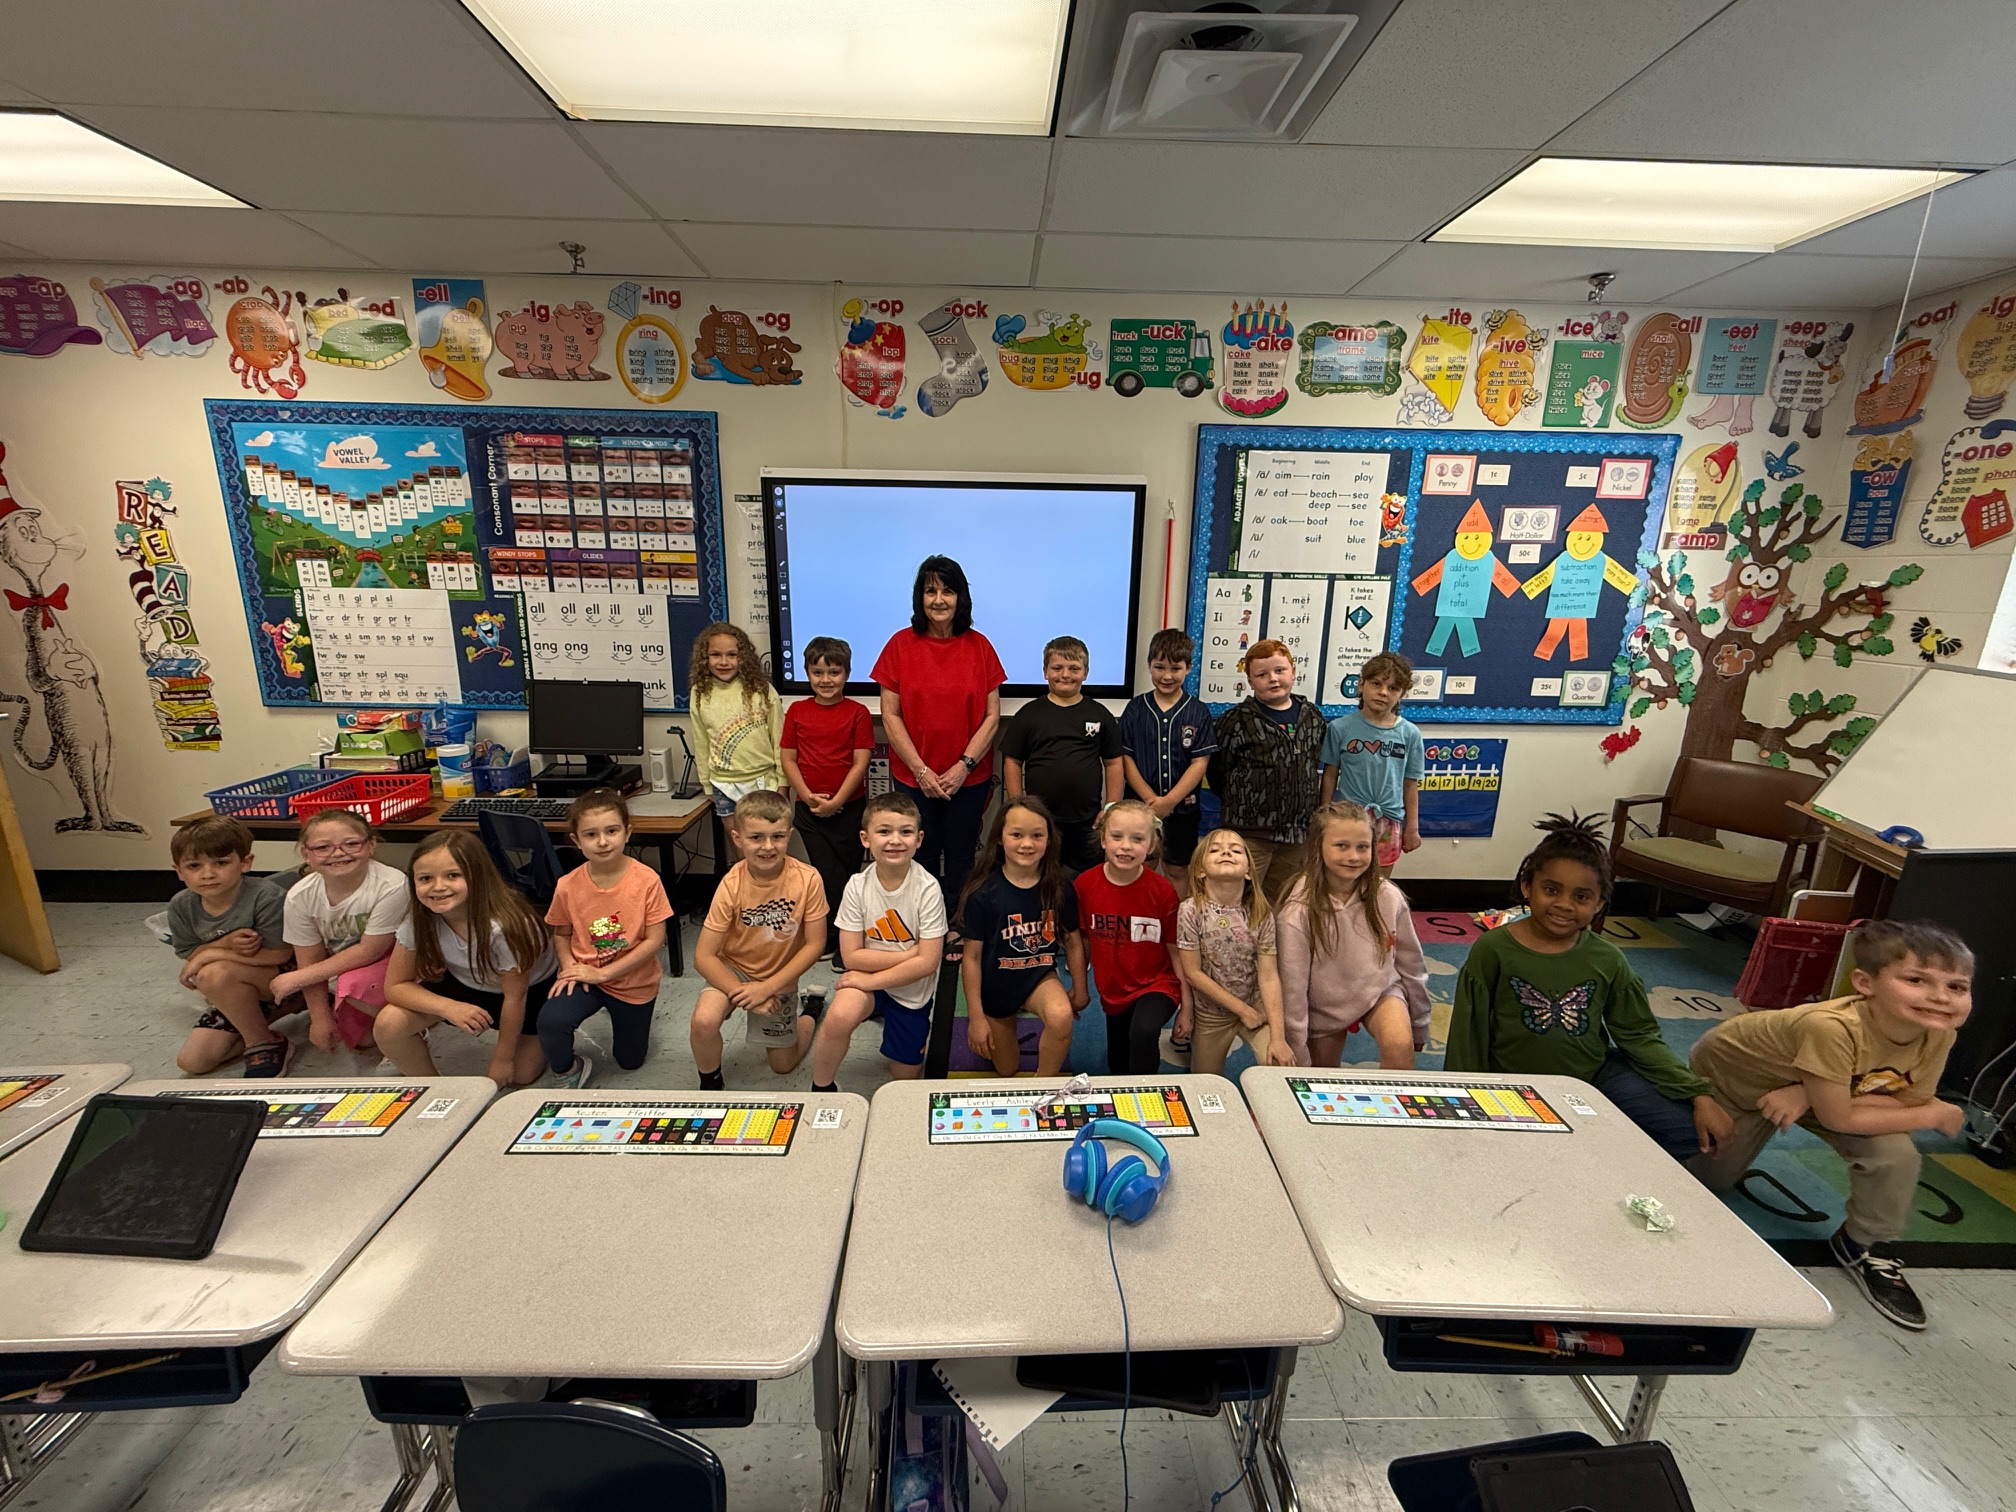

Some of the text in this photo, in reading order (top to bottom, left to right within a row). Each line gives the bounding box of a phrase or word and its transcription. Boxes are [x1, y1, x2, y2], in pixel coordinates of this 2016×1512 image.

[28, 281, 66, 300] -ap
[166, 280, 202, 299] -ag
[214, 276, 249, 295] -ab
[417, 284, 450, 302] -ell
[642, 287, 681, 309] -ing
[328, 308, 348, 317] bed
[361, 299, 395, 317] -ed
[523, 301, 550, 322] -ig
[870, 299, 904, 318] -op
[944, 300, 988, 318] -ock
[452, 314, 470, 322] bell
[722, 314, 742, 325] dog
[1441, 309, 1472, 326] -ite
[1910, 301, 1957, 327] -oat
[756, 312, 790, 332] -og
[1558, 319, 1594, 335] -ice
[1671, 316, 1702, 334] -ail
[509, 324, 527, 334] pig
[638, 329, 658, 340] ring
[1142, 323, 1186, 340] -uck
[1722, 324, 1759, 340] -eet
[1784, 322, 1827, 336] -eep
[933, 336, 957, 344] sock
[1112, 331, 1138, 340] truck
[1327, 328, 1377, 342] -ame
[1421, 336, 1439, 344] kite
[1249, 334, 1292, 352] -ake
[1493, 337, 1527, 354] -ive
[883, 347, 899, 355] top
[1227, 351, 1251, 359] cake
[1338, 346, 1366, 354] frame
[1001, 354, 1019, 364] bug
[1500, 360, 1519, 368] hive
[1070, 371, 1101, 389] -ug
[1952, 442, 2013, 461] -one
[1275, 471, 1292, 479] aim
[1354, 472, 1374, 483] play
[1863, 470, 1898, 486] -ow
[1233, 452, 1246, 522] ADJACENT VOWELS
[1438, 480, 1457, 488] Penny
[488, 445, 503, 536] Consonant Corner
[1310, 490, 1338, 498] beach
[1309, 501, 1331, 511] deep
[1271, 516, 1288, 524] oak
[1307, 517, 1328, 525] boat
[1467, 519, 1478, 527] add
[1305, 535, 1365, 544] suit blue
[1671, 532, 1719, 548] -amp
[1345, 552, 1356, 561] tie
[1454, 581, 1469, 590] plus
[1216, 588, 1231, 598] Aa
[1450, 599, 1467, 607] total
[530, 603, 652, 616] all oll ell ill ull
[1214, 613, 1222, 621] Ii
[1212, 637, 1228, 646] Oo
[534, 641, 664, 655] ang ong ing ung
[1210, 661, 1223, 670] Ee
[339, 672, 351, 680] spr
[376, 672, 387, 680] spl
[395, 672, 408, 680] squ
[643, 679, 666, 690] unk
[1208, 684, 1223, 692] Uu
[1428, 779, 1437, 787] 16
[1458, 778, 1465, 786] 18
[1426, 917, 1466, 936] S
[1673, 996, 1722, 1012] 10
[967, 1097, 1034, 1107] Everly Ashley
[628, 1109, 666, 1117] Pfeiffer
